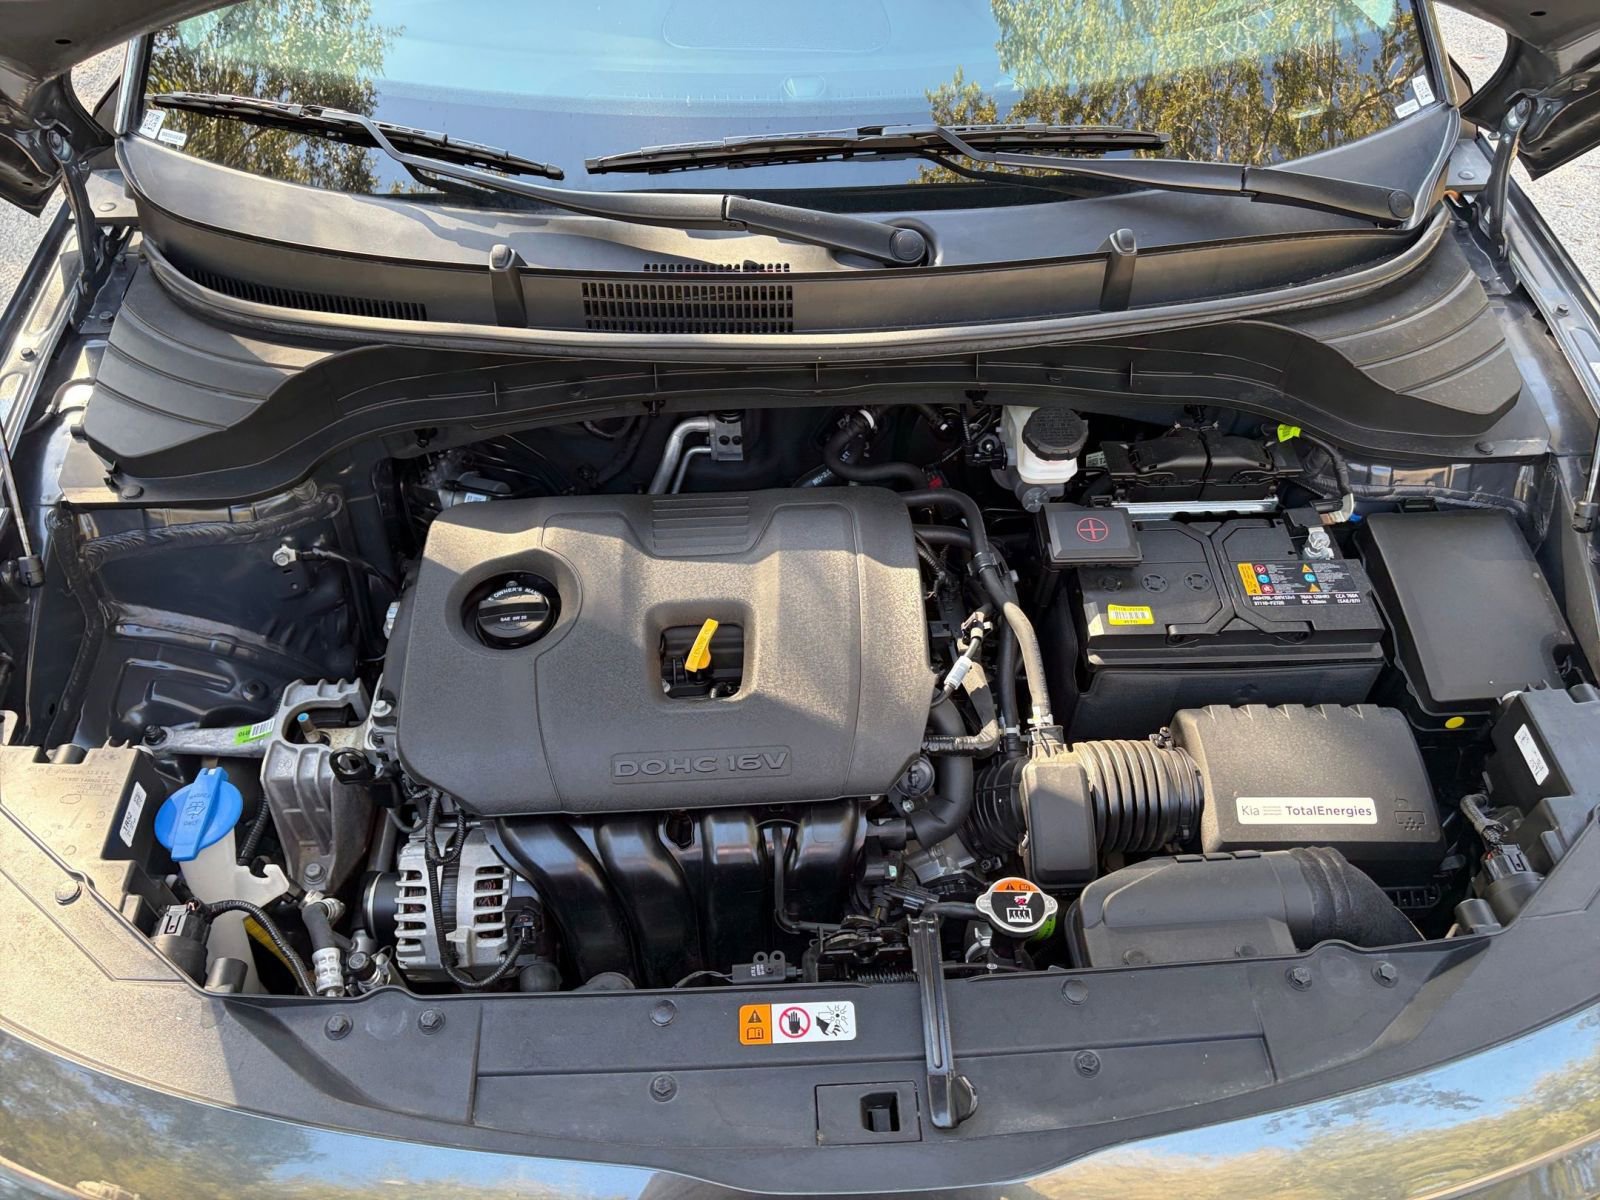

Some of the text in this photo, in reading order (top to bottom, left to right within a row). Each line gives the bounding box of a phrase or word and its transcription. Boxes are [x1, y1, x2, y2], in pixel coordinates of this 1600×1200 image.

[614, 752, 788, 778] DOHC 16V
[1241, 805, 1372, 818] Kia TotalEnergies
